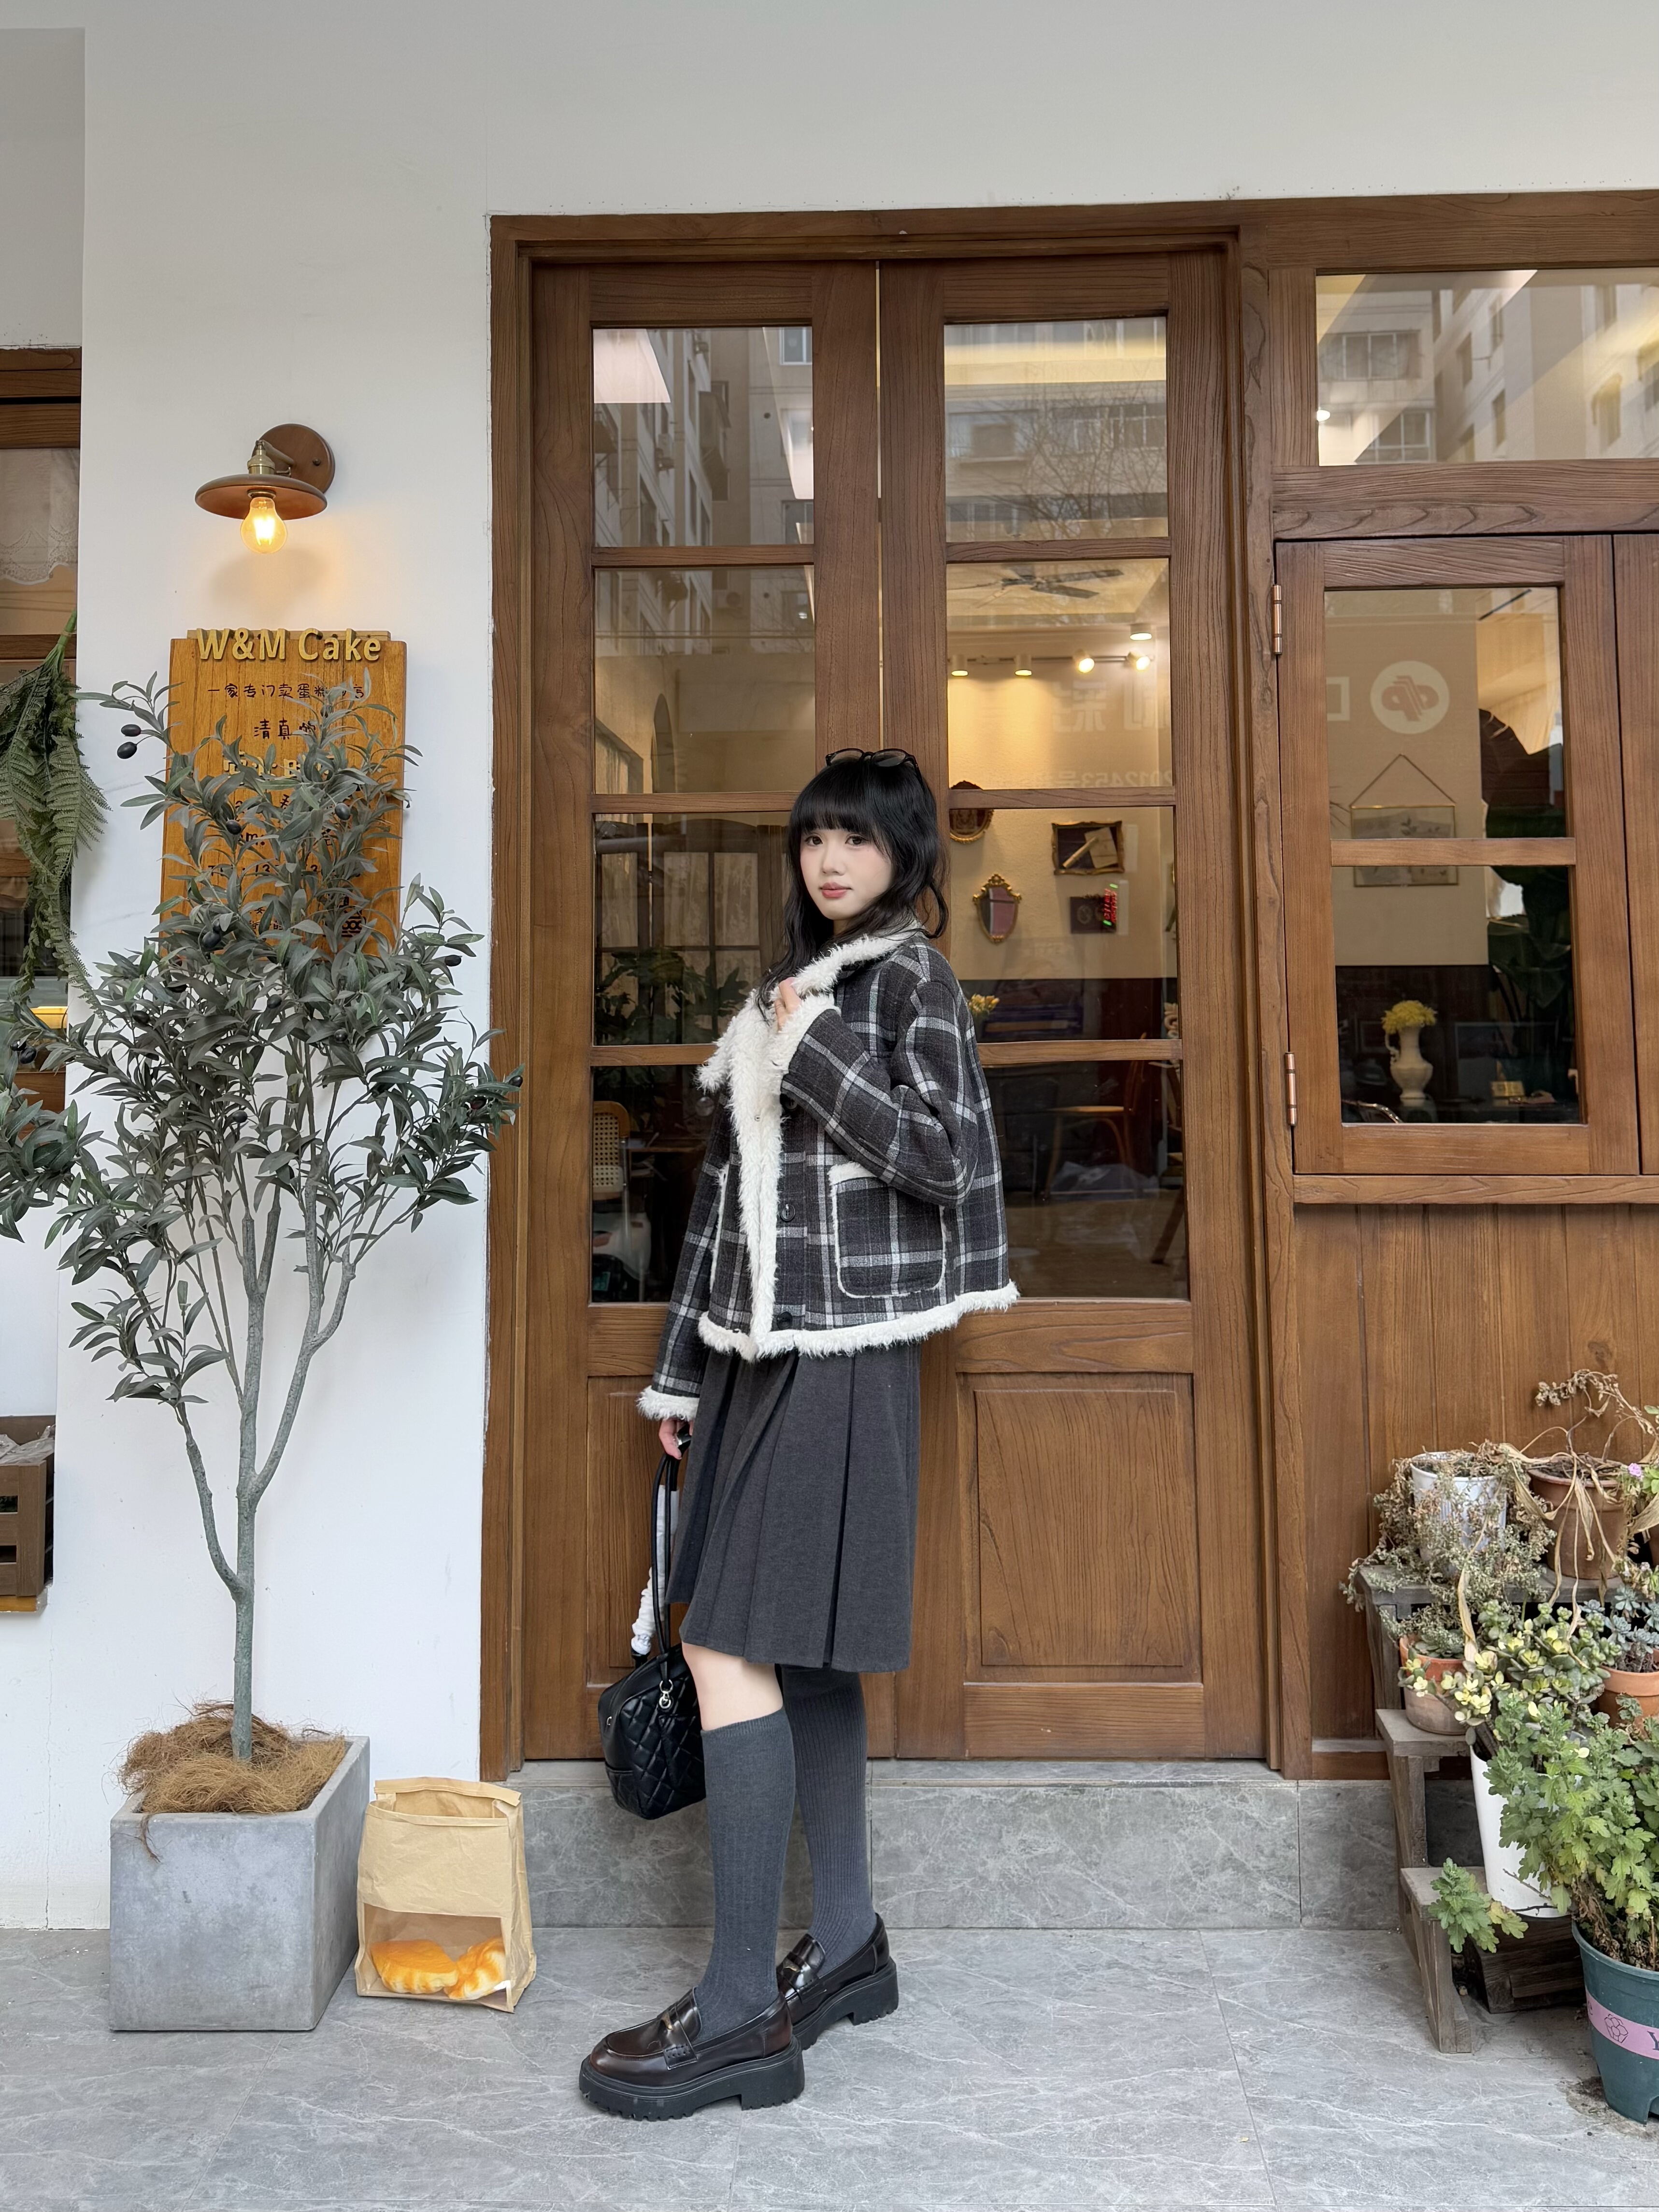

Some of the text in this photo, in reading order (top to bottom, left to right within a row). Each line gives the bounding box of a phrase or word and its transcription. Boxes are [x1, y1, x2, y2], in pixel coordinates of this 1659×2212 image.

[196, 628, 381, 661] W&M Cake
[207, 683, 365, 699] 一家专门卖蛋店
